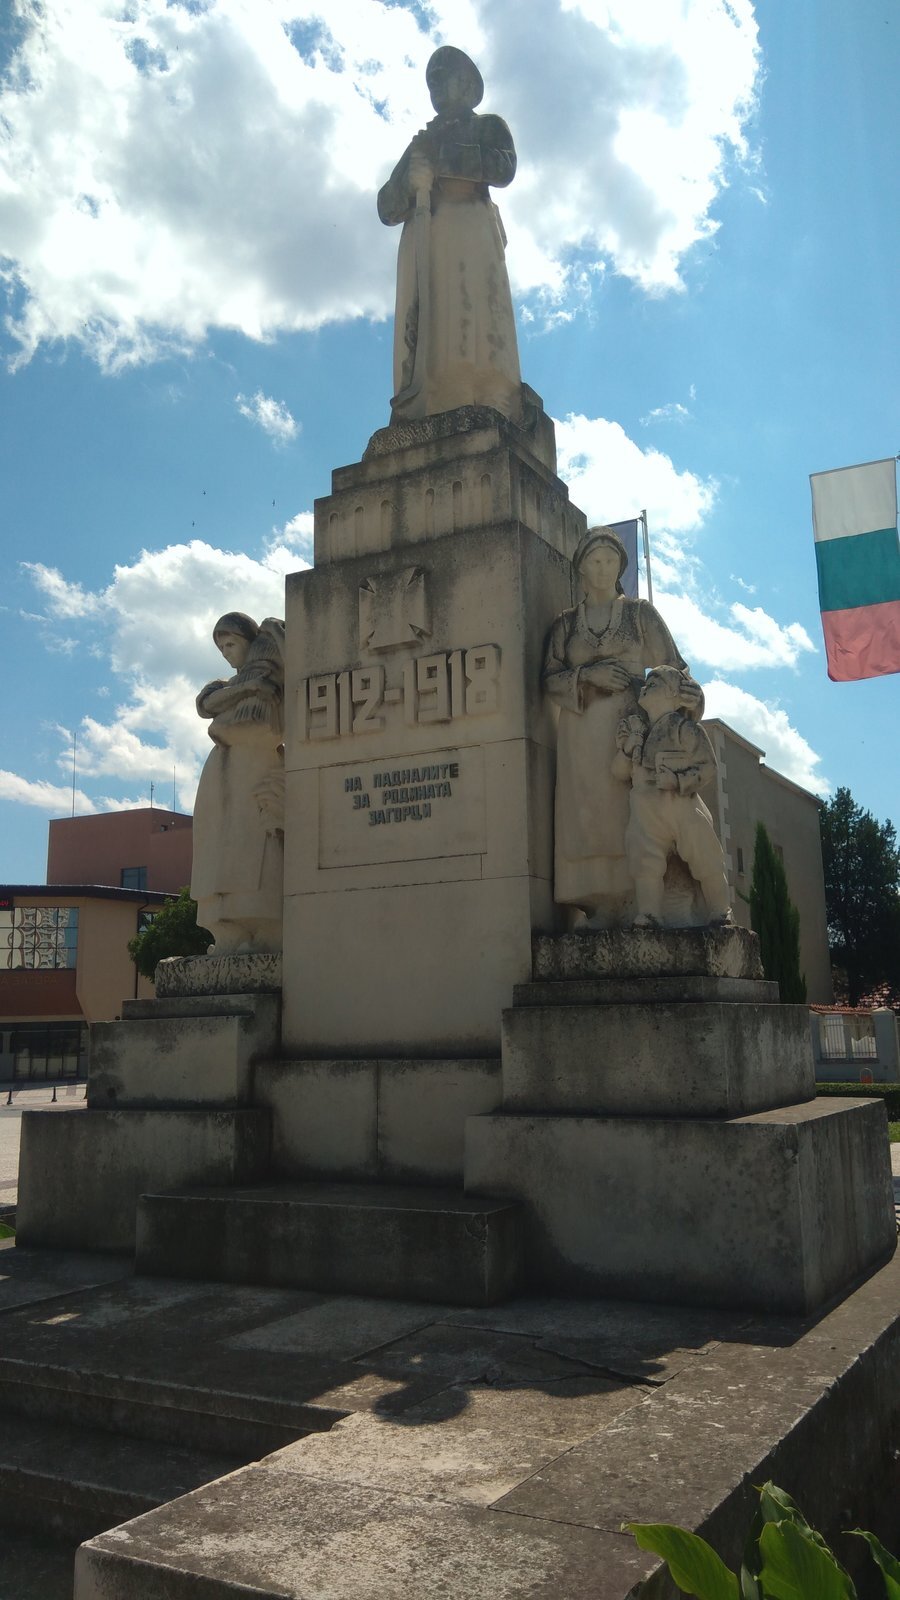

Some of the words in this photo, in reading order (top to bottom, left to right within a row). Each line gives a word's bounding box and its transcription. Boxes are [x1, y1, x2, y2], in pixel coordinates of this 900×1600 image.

[297, 643, 501, 741] 1912-1918
[344, 776, 362, 792] НА
[373, 763, 459, 788] ПАДНАЛИТЕ
[352, 793, 371, 810] ЗА
[382, 781, 452, 805] РОДИНАТА
[368, 803, 432, 826] ЗАГОРЦИ
